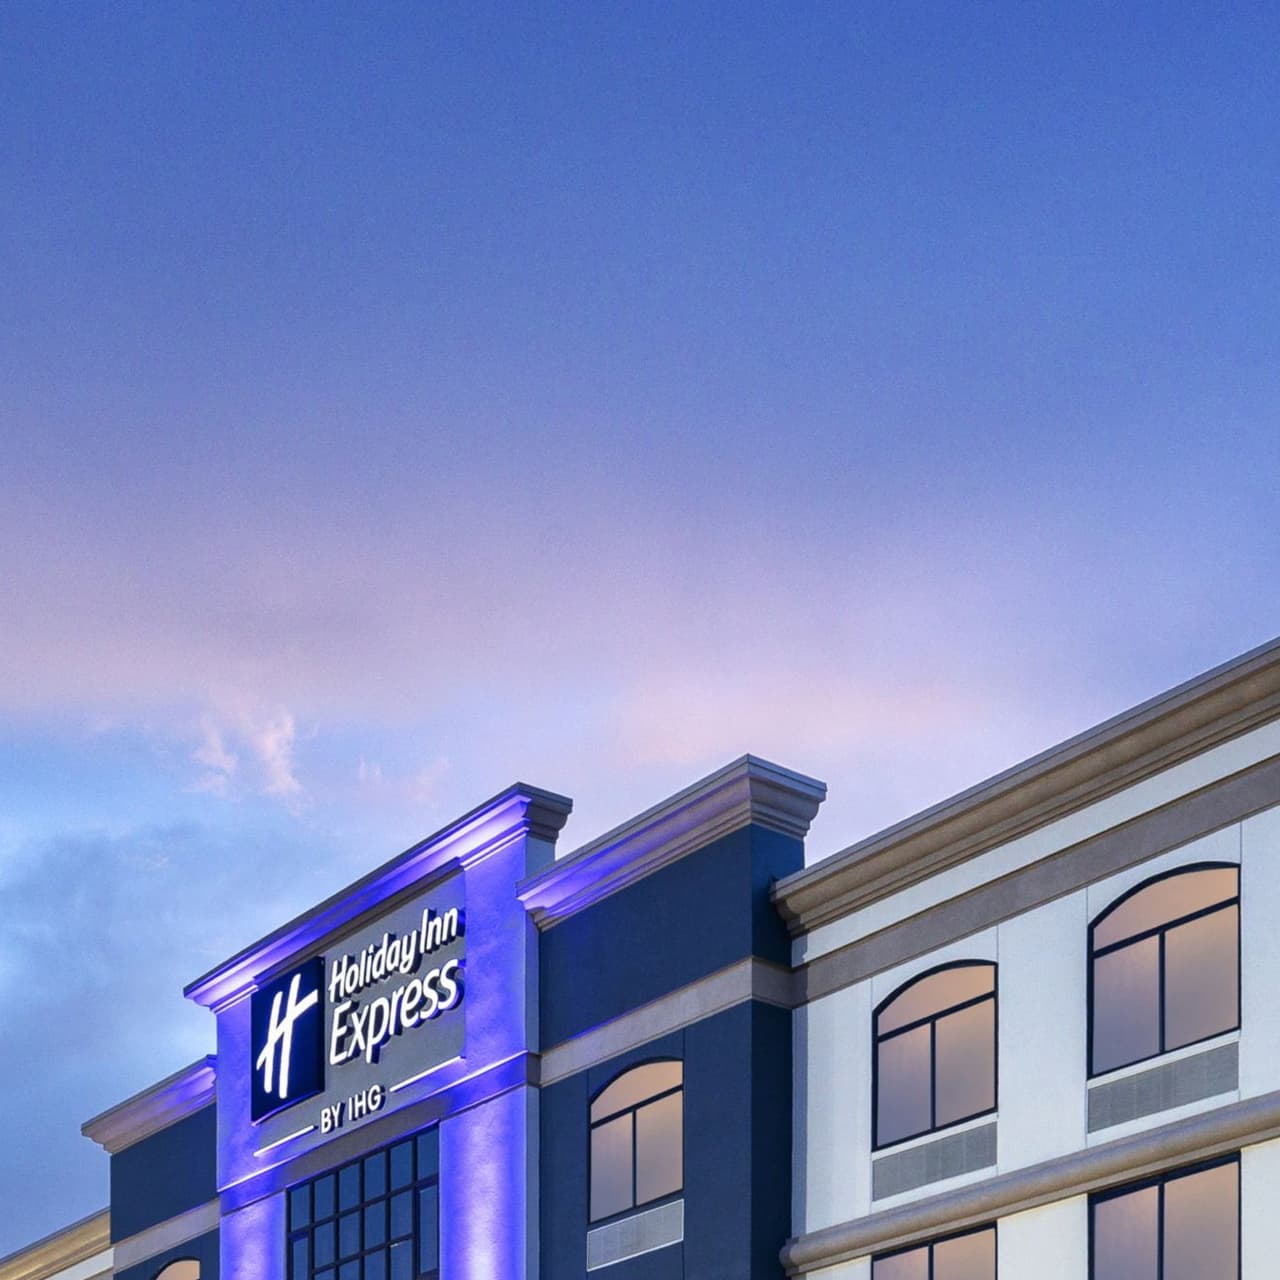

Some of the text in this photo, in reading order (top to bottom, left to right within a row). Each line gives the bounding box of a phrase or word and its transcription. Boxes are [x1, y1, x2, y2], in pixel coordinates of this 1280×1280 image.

[329, 907, 458, 1002] Holiday Inn
[329, 959, 459, 1065] Express
[321, 1085, 382, 1134] BY IHG
